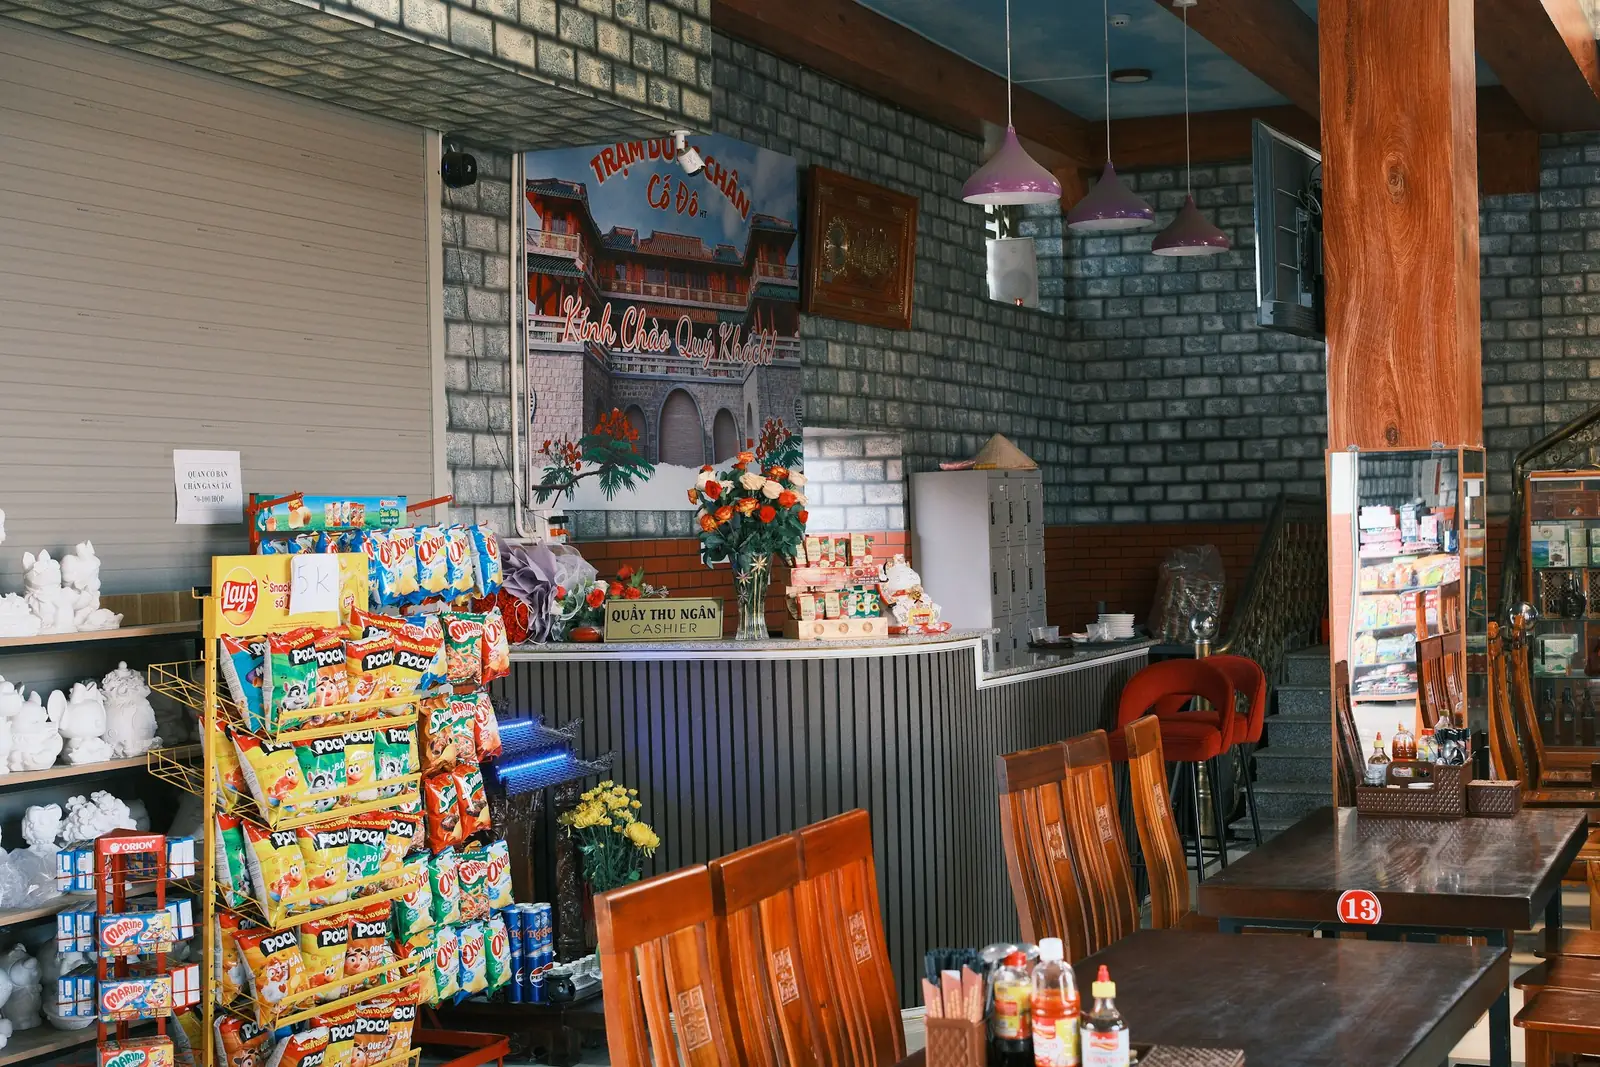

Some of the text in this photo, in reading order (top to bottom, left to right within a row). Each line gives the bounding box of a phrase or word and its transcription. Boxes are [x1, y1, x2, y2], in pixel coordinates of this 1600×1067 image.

[647, 174, 698, 217] Cố Đô
[704, 155, 751, 220] CHÂN
[563, 295, 777, 369] Kính Chào Quý Khách!
[222, 582, 256, 613] Lay's
[611, 604, 716, 623] QUẦY THU NGÂN
[630, 623, 698, 635] CASHIER
[317, 648, 344, 667] POCA
[366, 651, 393, 669] POCA
[398, 651, 430, 670] POCA
[350, 829, 384, 845] POCA
[388, 819, 413, 836] OCA
[122, 841, 153, 851] ORION
[1345, 898, 1376, 920] 13
[356, 922, 386, 938] POCA
[261, 931, 297, 953] POCA
[393, 1006, 415, 1020] OCA
[356, 1018, 389, 1033] POCA
